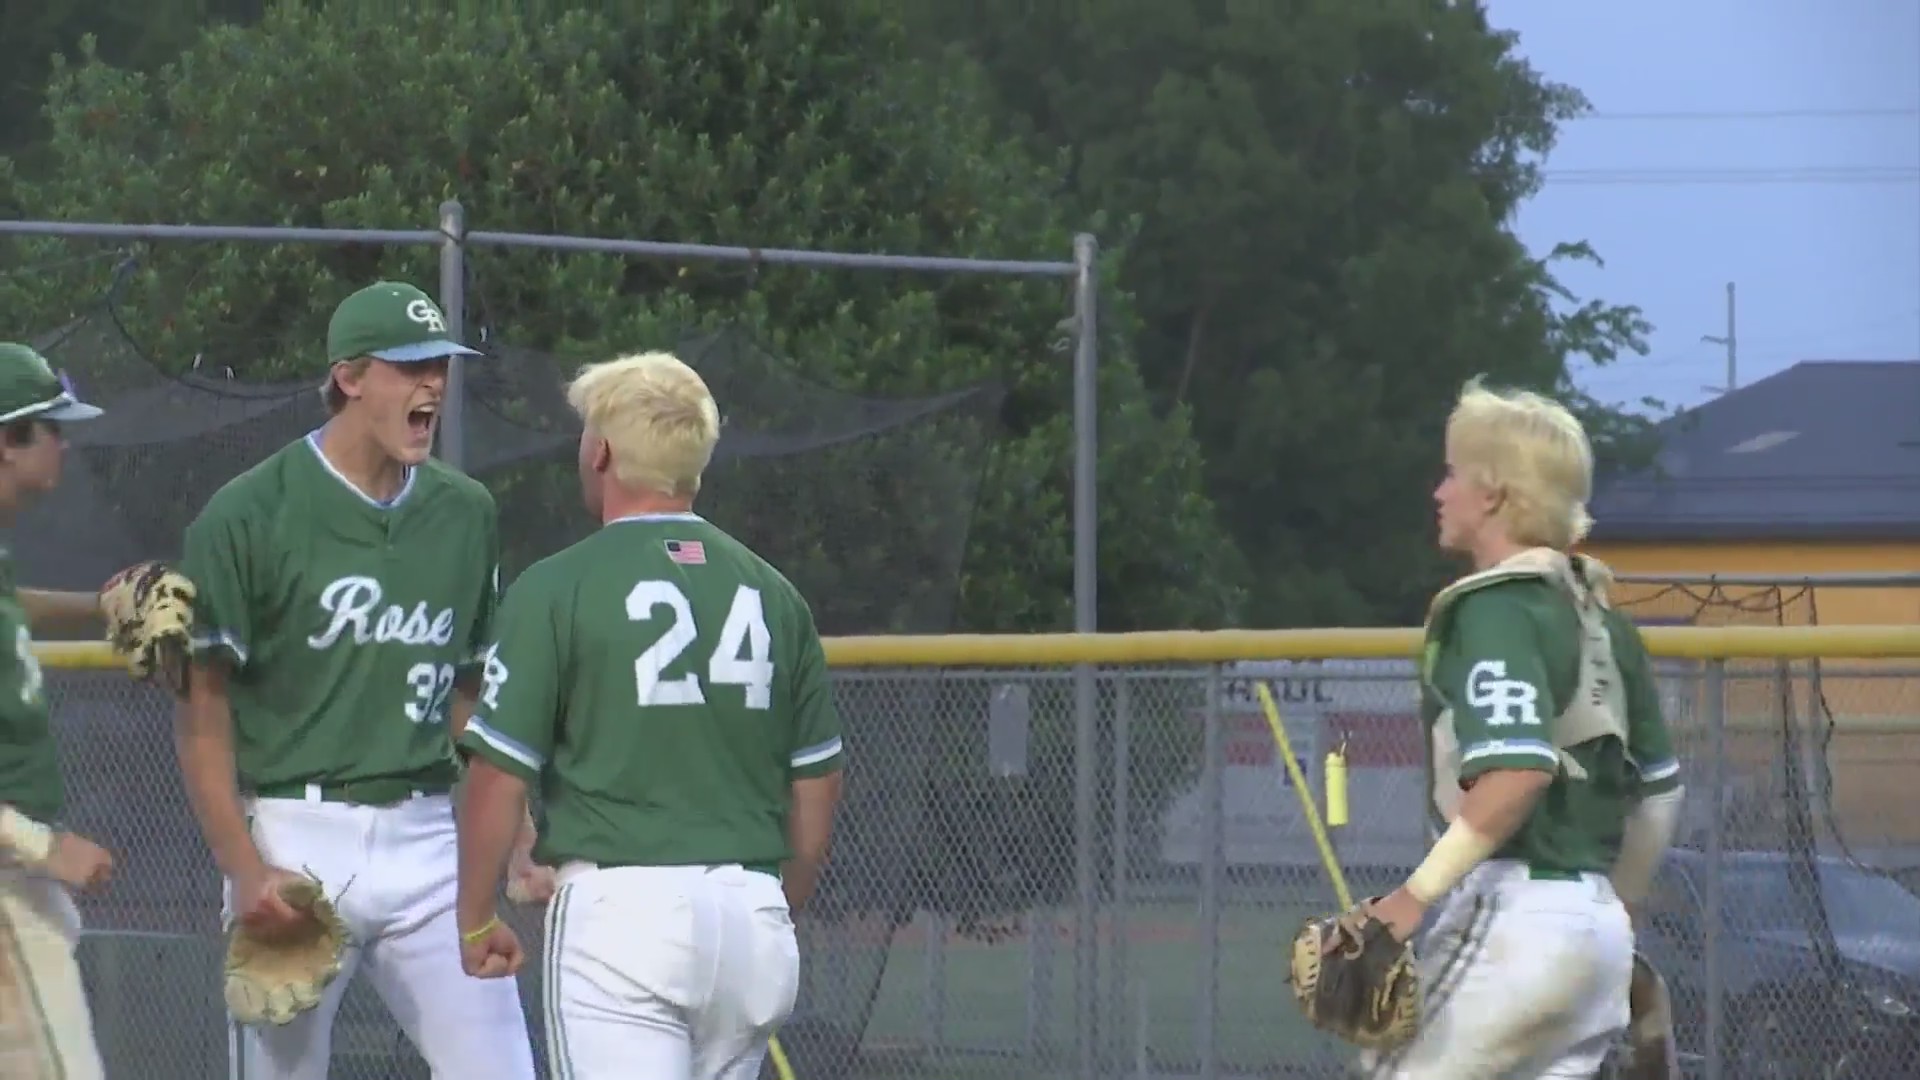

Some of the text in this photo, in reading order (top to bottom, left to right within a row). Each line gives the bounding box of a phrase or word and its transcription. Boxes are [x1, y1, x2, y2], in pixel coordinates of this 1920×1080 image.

[407, 299, 447, 332] GR
[307, 575, 454, 649] Rose
[625, 579, 774, 710] 24
[404, 662, 455, 724] 32
[1466, 660, 1542, 725] GR
